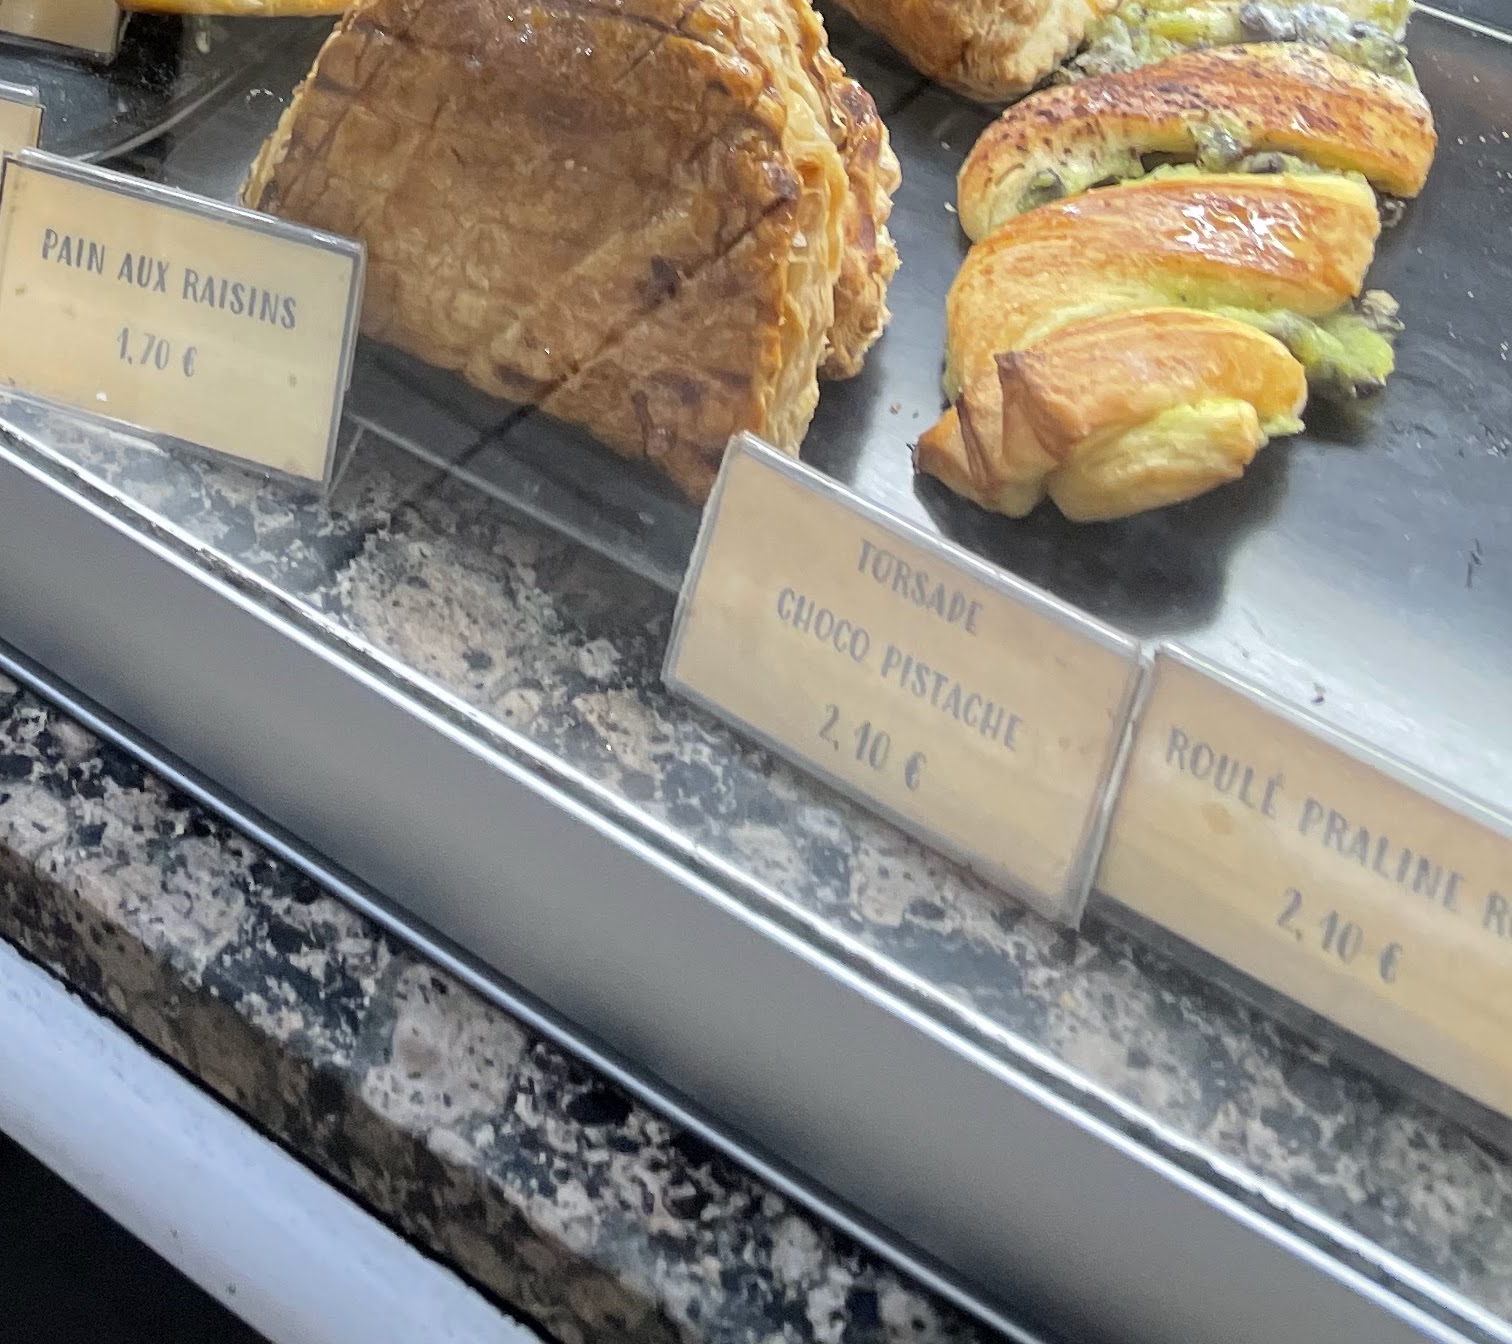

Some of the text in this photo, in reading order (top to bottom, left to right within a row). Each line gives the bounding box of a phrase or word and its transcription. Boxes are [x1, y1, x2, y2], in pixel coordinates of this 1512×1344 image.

[41, 227, 298, 330] PAIN AUX RAISINS
[182, 345, 197, 378] €
[857, 537, 984, 638] TORSADE
[777, 586, 1024, 753] CHOCO PISTACHE
[904, 750, 928, 792] €
[1164, 723, 1285, 820] ROULÉ
[1298, 795, 1465, 914] PRALINE
[1377, 939, 1404, 985] €
